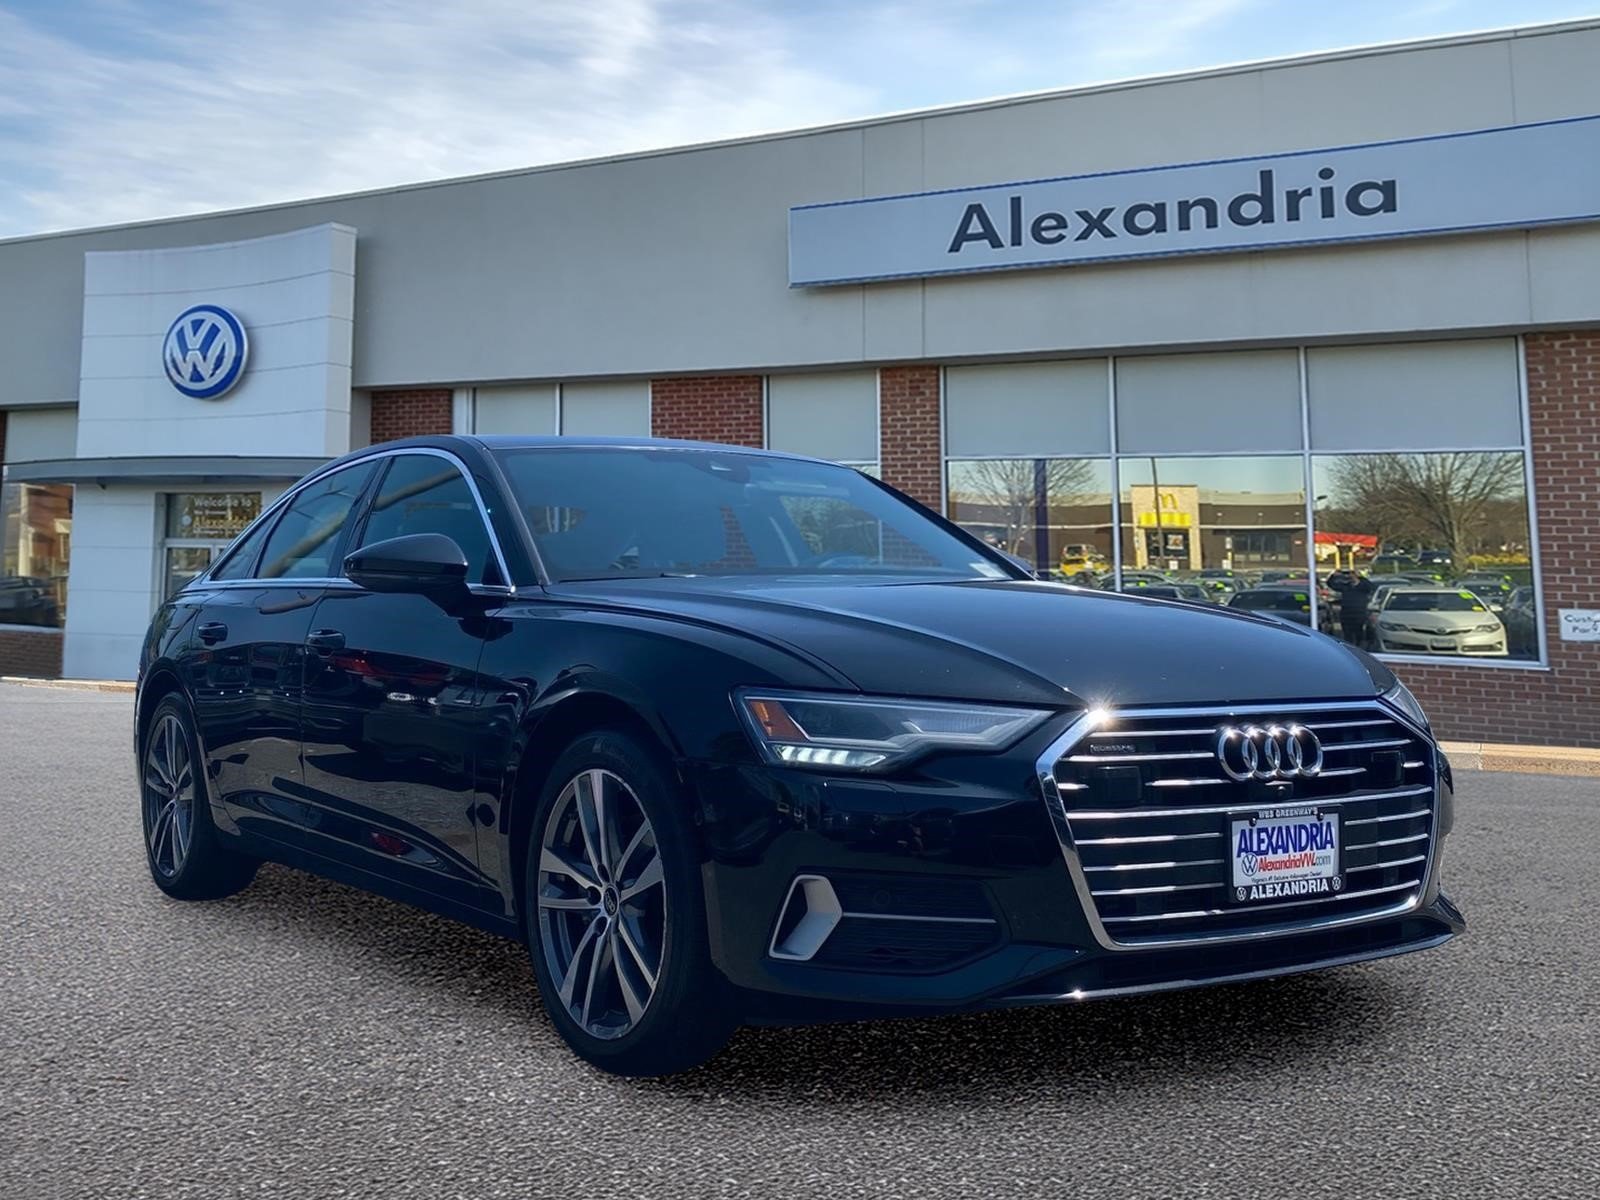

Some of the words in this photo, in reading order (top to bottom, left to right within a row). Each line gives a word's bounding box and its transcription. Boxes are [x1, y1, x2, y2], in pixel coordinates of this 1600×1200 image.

[948, 167, 1398, 253] Alexandria
[1564, 614, 1594, 623] Cust
[1236, 821, 1335, 858] ALEXANDRIA
[1250, 879, 1329, 899] ALEXANDRIA
